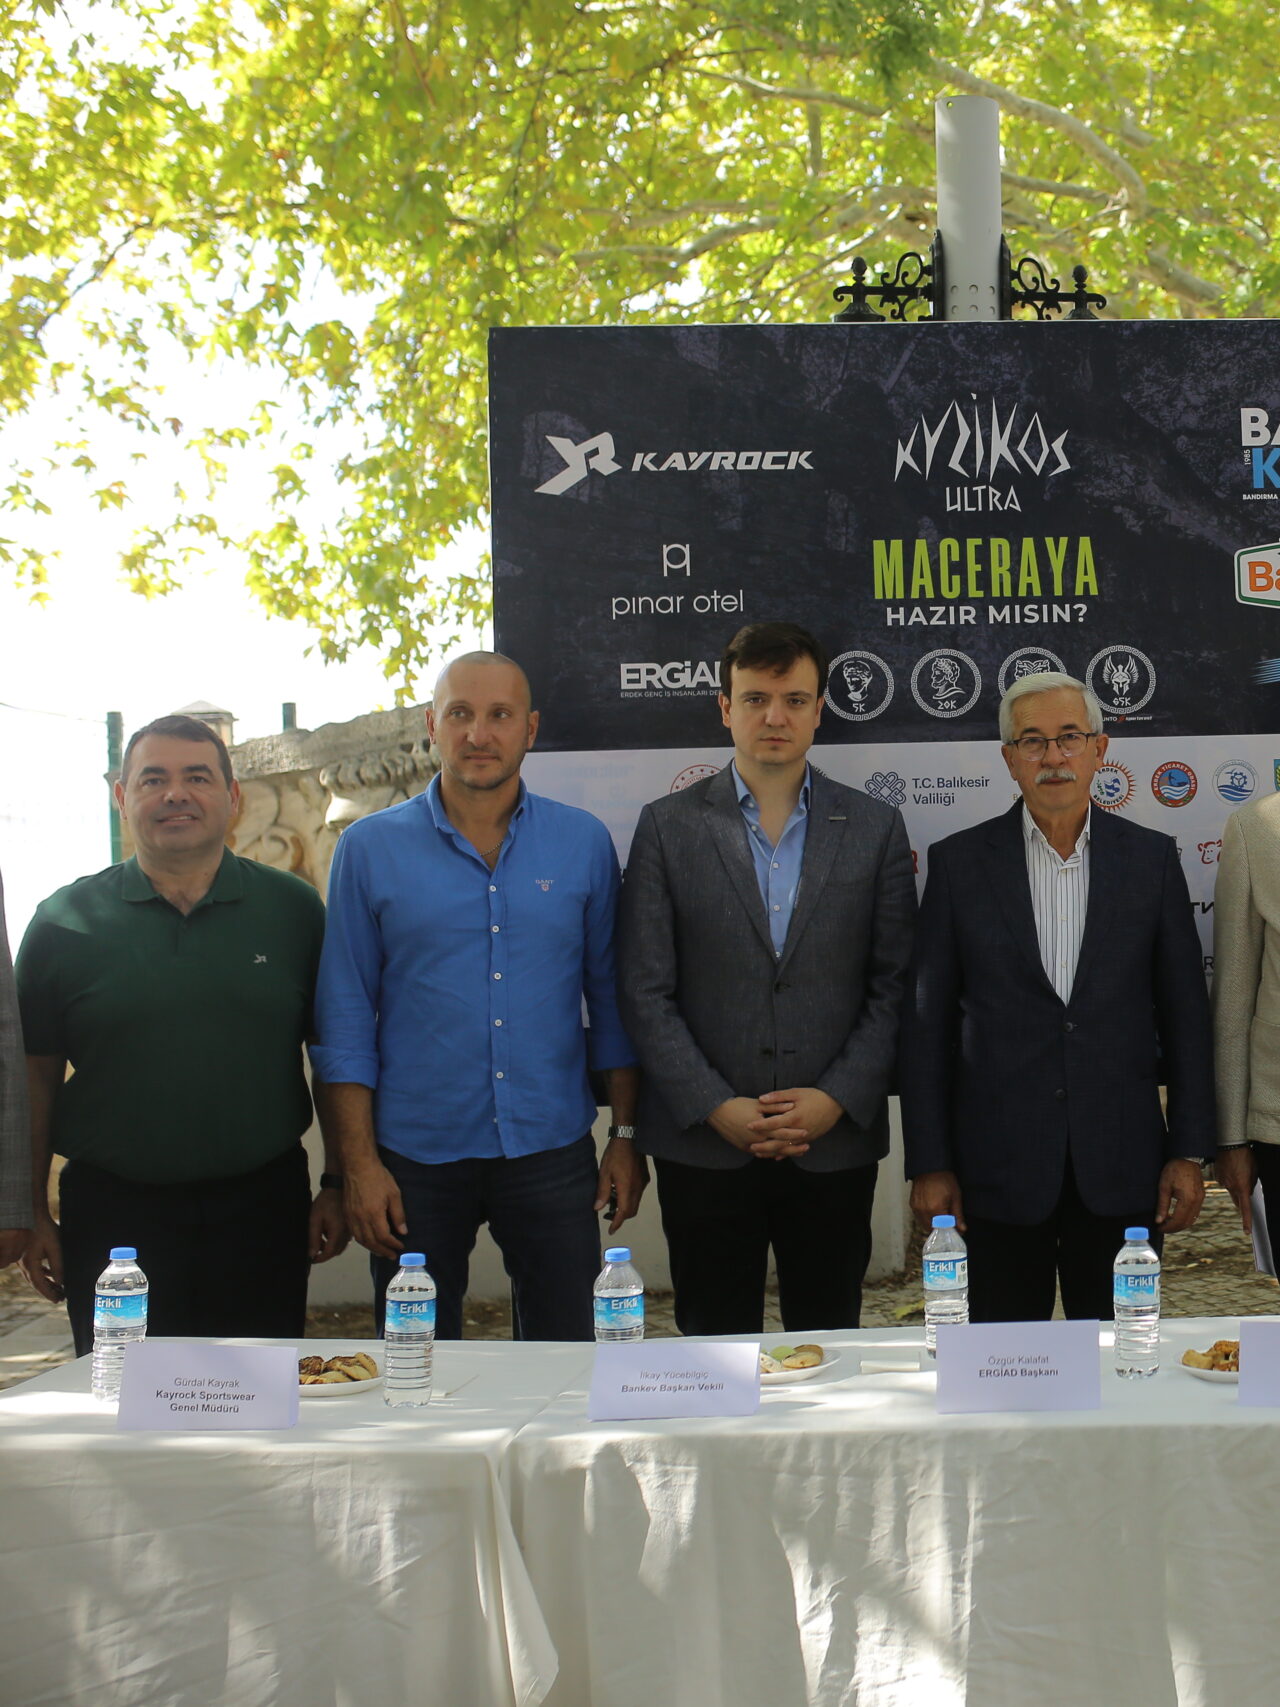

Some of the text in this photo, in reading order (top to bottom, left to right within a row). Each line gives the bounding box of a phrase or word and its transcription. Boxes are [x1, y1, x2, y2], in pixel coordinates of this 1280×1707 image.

[631, 450, 815, 472] KAYROCK
[1243, 449, 1251, 466] 1985
[945, 484, 1022, 512] ULTRA
[872, 536, 1099, 600] MACERAYA
[692, 590, 745, 614] otel
[886, 603, 1089, 627] HAZIR MISIN?
[620, 690, 644, 698] ERDEK
[644, 689, 663, 698] GENÇ
[852, 703, 865, 713] 5K
[937, 700, 957, 710] 20K
[912, 776, 991, 789] T.C. Balıkesir
[912, 792, 956, 807] Valiliği
[929, 1261, 955, 1273] Erikli
[1127, 1276, 1154, 1287] Erikli
[97, 1297, 122, 1308] Erikli
[611, 1297, 638, 1310] Erikli
[400, 1303, 428, 1314] Erikli
[988, 1355, 1015, 1366] Özgür
[1020, 1367, 1059, 1378] Başkanı
[174, 1377, 240, 1389] Gürdal Kayrak
[621, 1383, 724, 1393] Bankev Başkan Vekili
[156, 1390, 256, 1401] Kayrock Sportswear
[170, 1403, 240, 1413] Genel Müdürü
